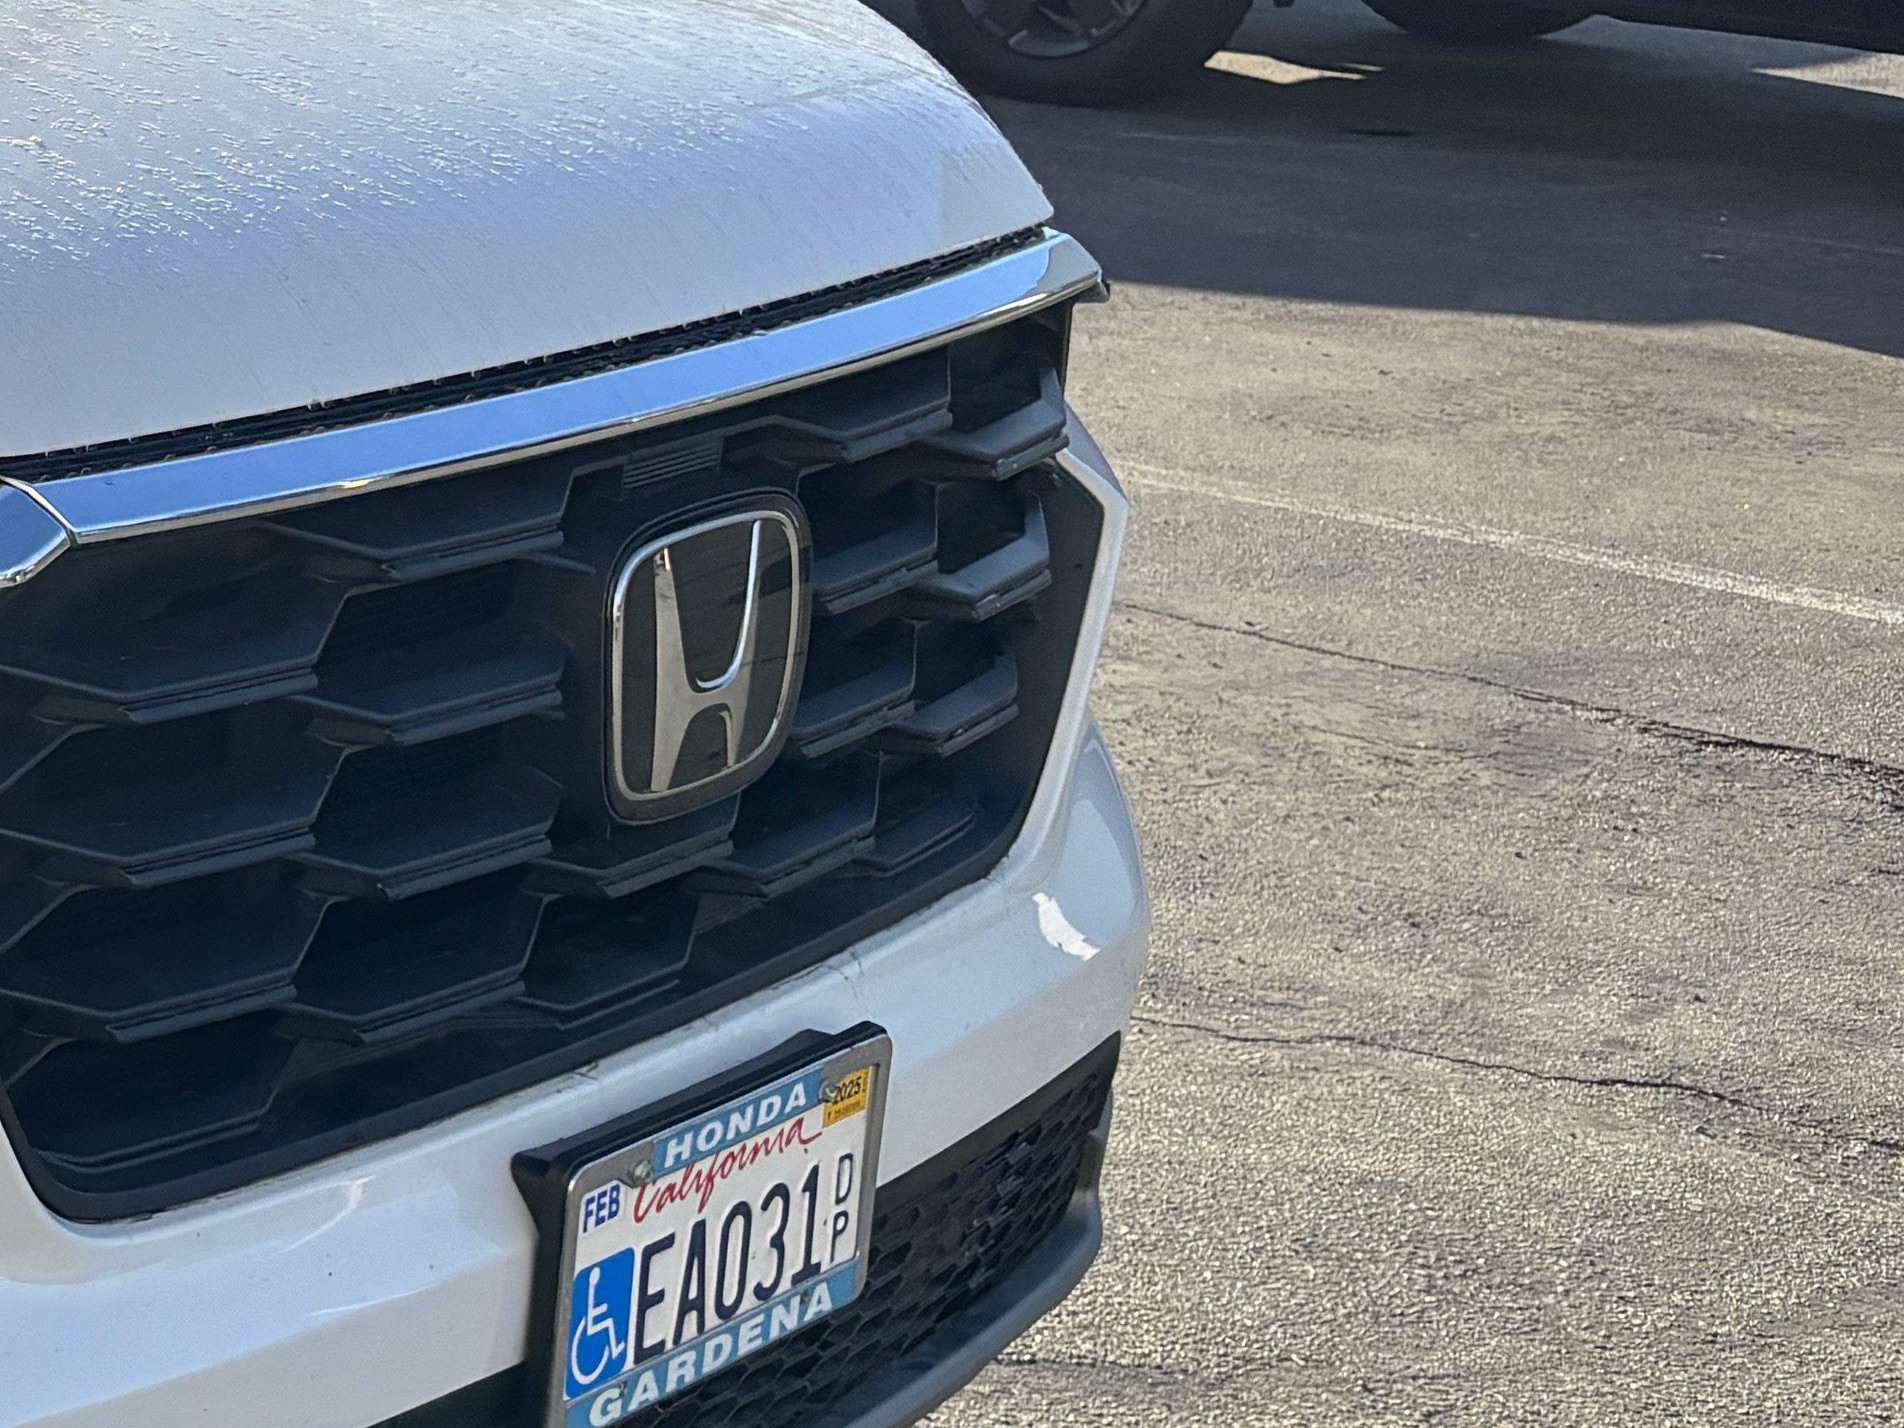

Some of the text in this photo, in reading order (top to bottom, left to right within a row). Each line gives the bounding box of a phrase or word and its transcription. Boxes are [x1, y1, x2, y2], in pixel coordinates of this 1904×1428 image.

[632, 1116, 822, 1223] California
[663, 1082, 806, 1170] HONDA
[583, 1184, 621, 1233] FEB
[633, 1163, 821, 1366] EA031
[588, 1280, 833, 1428] GARDENA
